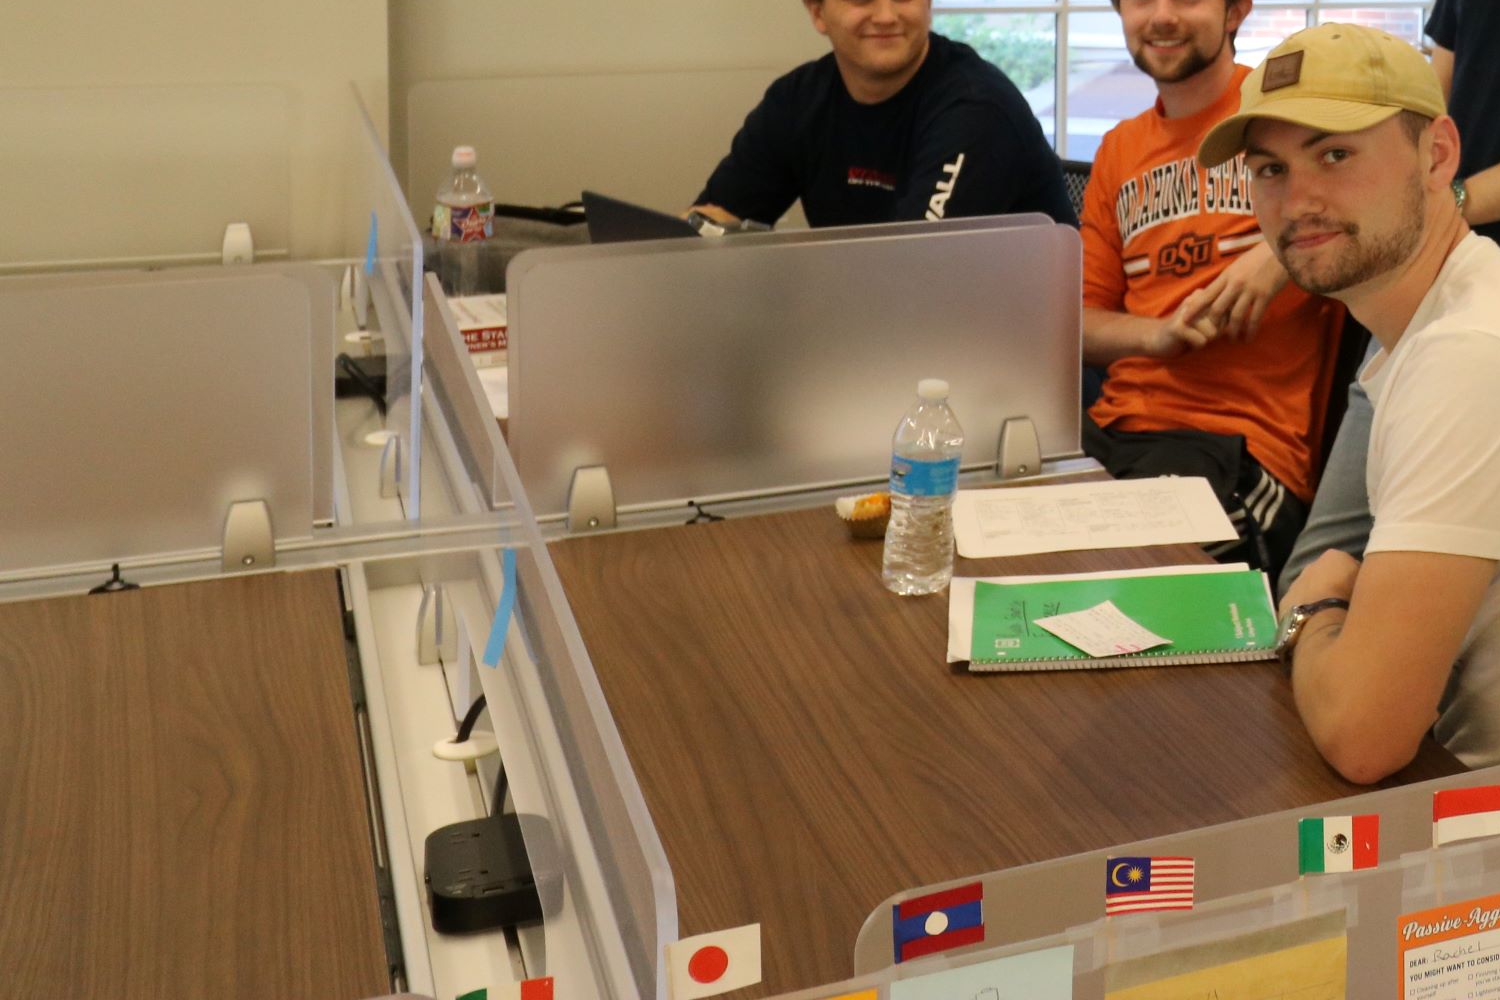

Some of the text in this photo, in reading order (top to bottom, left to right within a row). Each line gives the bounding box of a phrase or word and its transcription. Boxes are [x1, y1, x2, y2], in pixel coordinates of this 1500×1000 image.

[1116, 151, 1255, 249] OKLAHOMA STAT
[1157, 233, 1216, 278] OSU
[482, 328, 507, 343] STA
[1409, 957, 1429, 969] DEAR:
[1432, 940, 1482, 963] Rachel
[1409, 973, 1423, 983] YOU
[1424, 966, 1445, 979] MIGHT
[1446, 961, 1466, 973] WANT
[1467, 958, 1475, 968] TO
